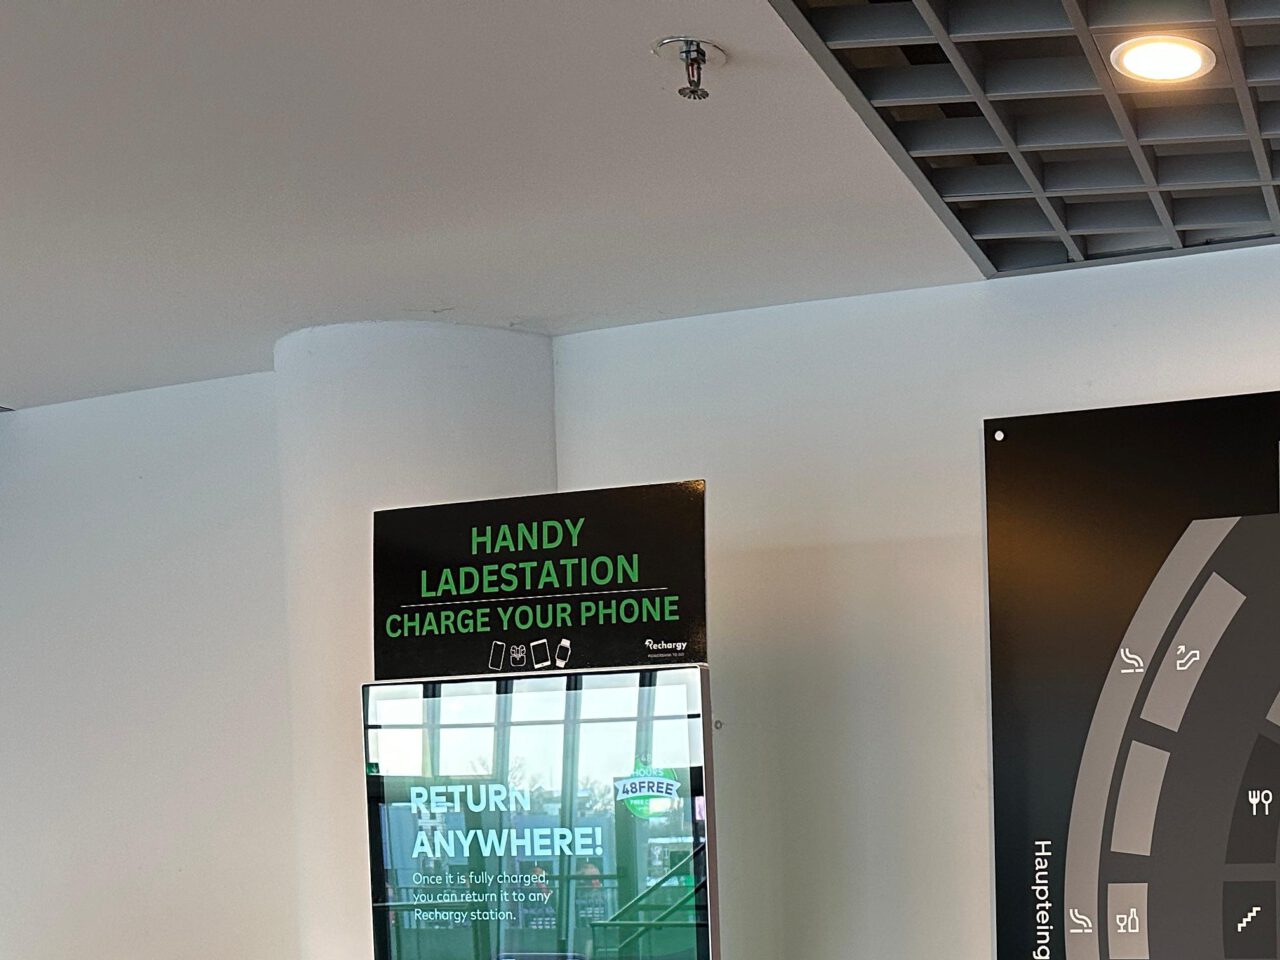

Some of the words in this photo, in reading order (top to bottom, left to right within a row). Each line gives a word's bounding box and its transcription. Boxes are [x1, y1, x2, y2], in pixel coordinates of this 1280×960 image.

[471, 517, 585, 555] HANDY
[421, 553, 639, 598] LADESTATION
[385, 607, 490, 638] CHARGE
[497, 602, 573, 631] YOUR
[581, 595, 680, 626] PHONE
[644, 638, 688, 651] Rechargy
[410, 783, 532, 814] RETURN
[621, 780, 675, 796] 48FREE
[411, 827, 603, 858] ANYWHERE!
[412, 872, 442, 885] Once
[445, 872, 454, 885] it
[456, 872, 466, 885] is
[468, 871, 494, 887] fully
[496, 870, 549, 887] charged,
[413, 892, 434, 906] you
[436, 892, 458, 903] can
[460, 891, 497, 903] return
[499, 890, 509, 902] it
[512, 891, 526, 902] to
[528, 892, 552, 906] any
[414, 908, 468, 923] Rechargy
[470, 908, 516, 921] station.
